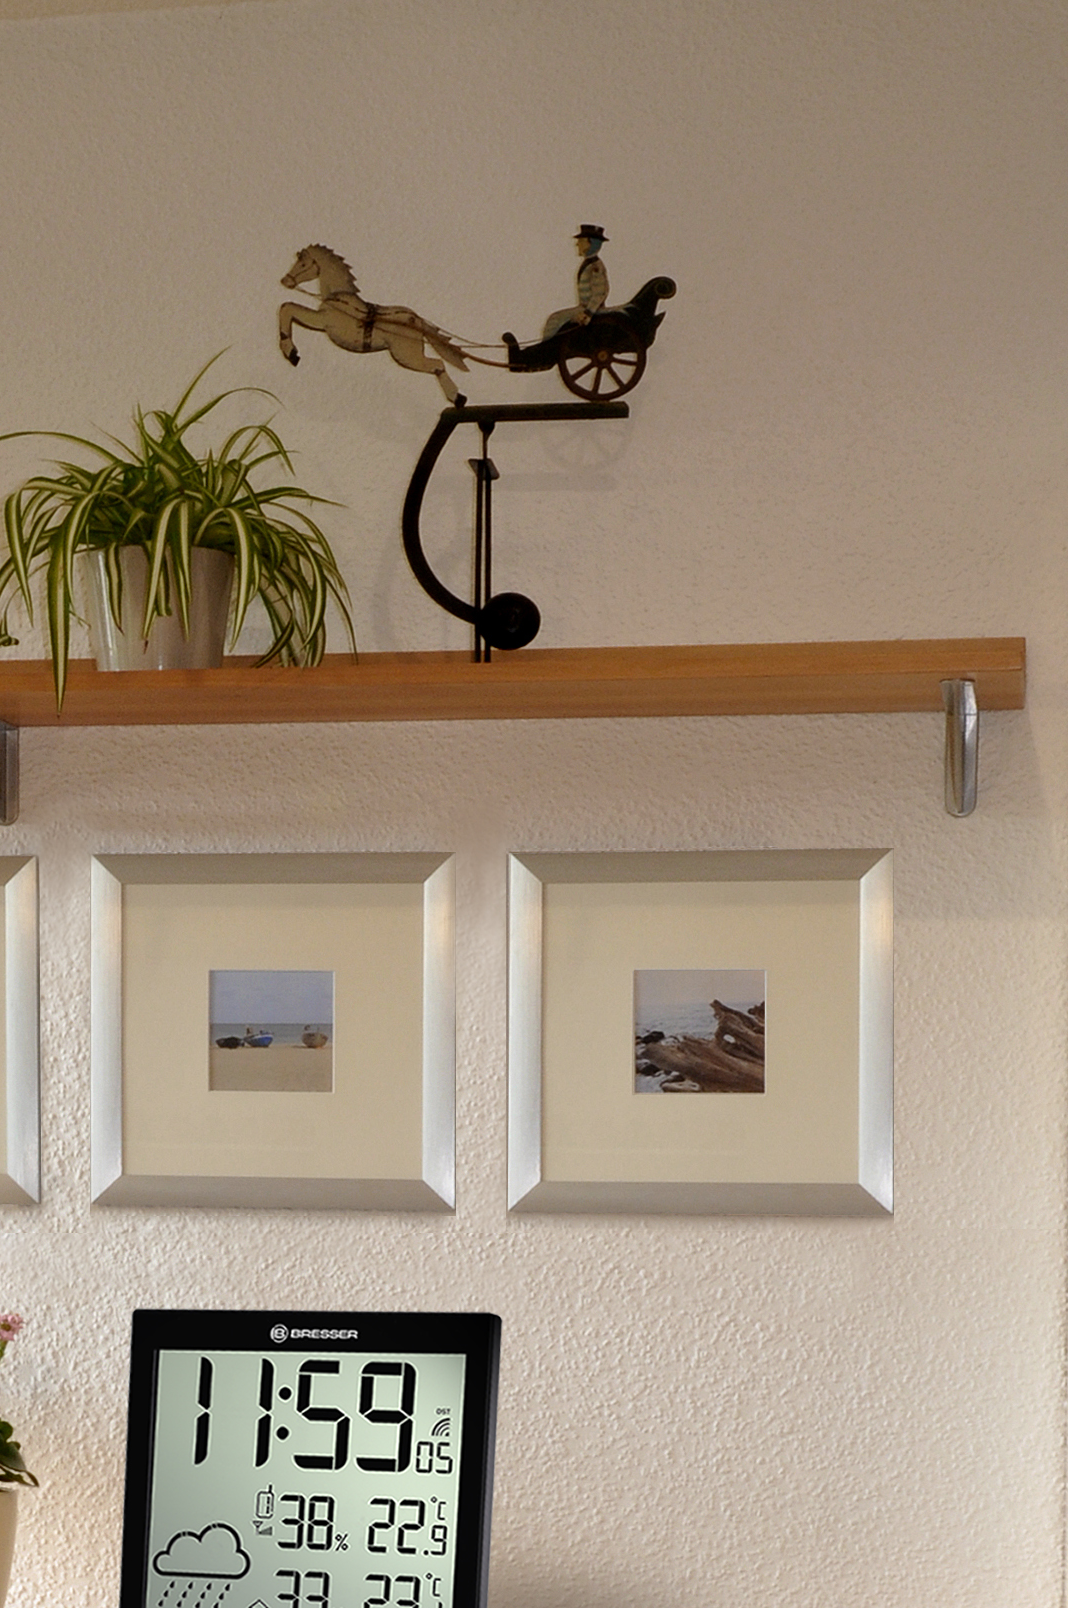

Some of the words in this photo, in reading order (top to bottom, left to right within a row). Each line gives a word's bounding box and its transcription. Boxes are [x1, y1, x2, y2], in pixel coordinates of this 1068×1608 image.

[290, 1328, 358, 1339] BRESSER
[194, 1356, 417, 1472] 11:59
[415, 1441, 453, 1474] 05
